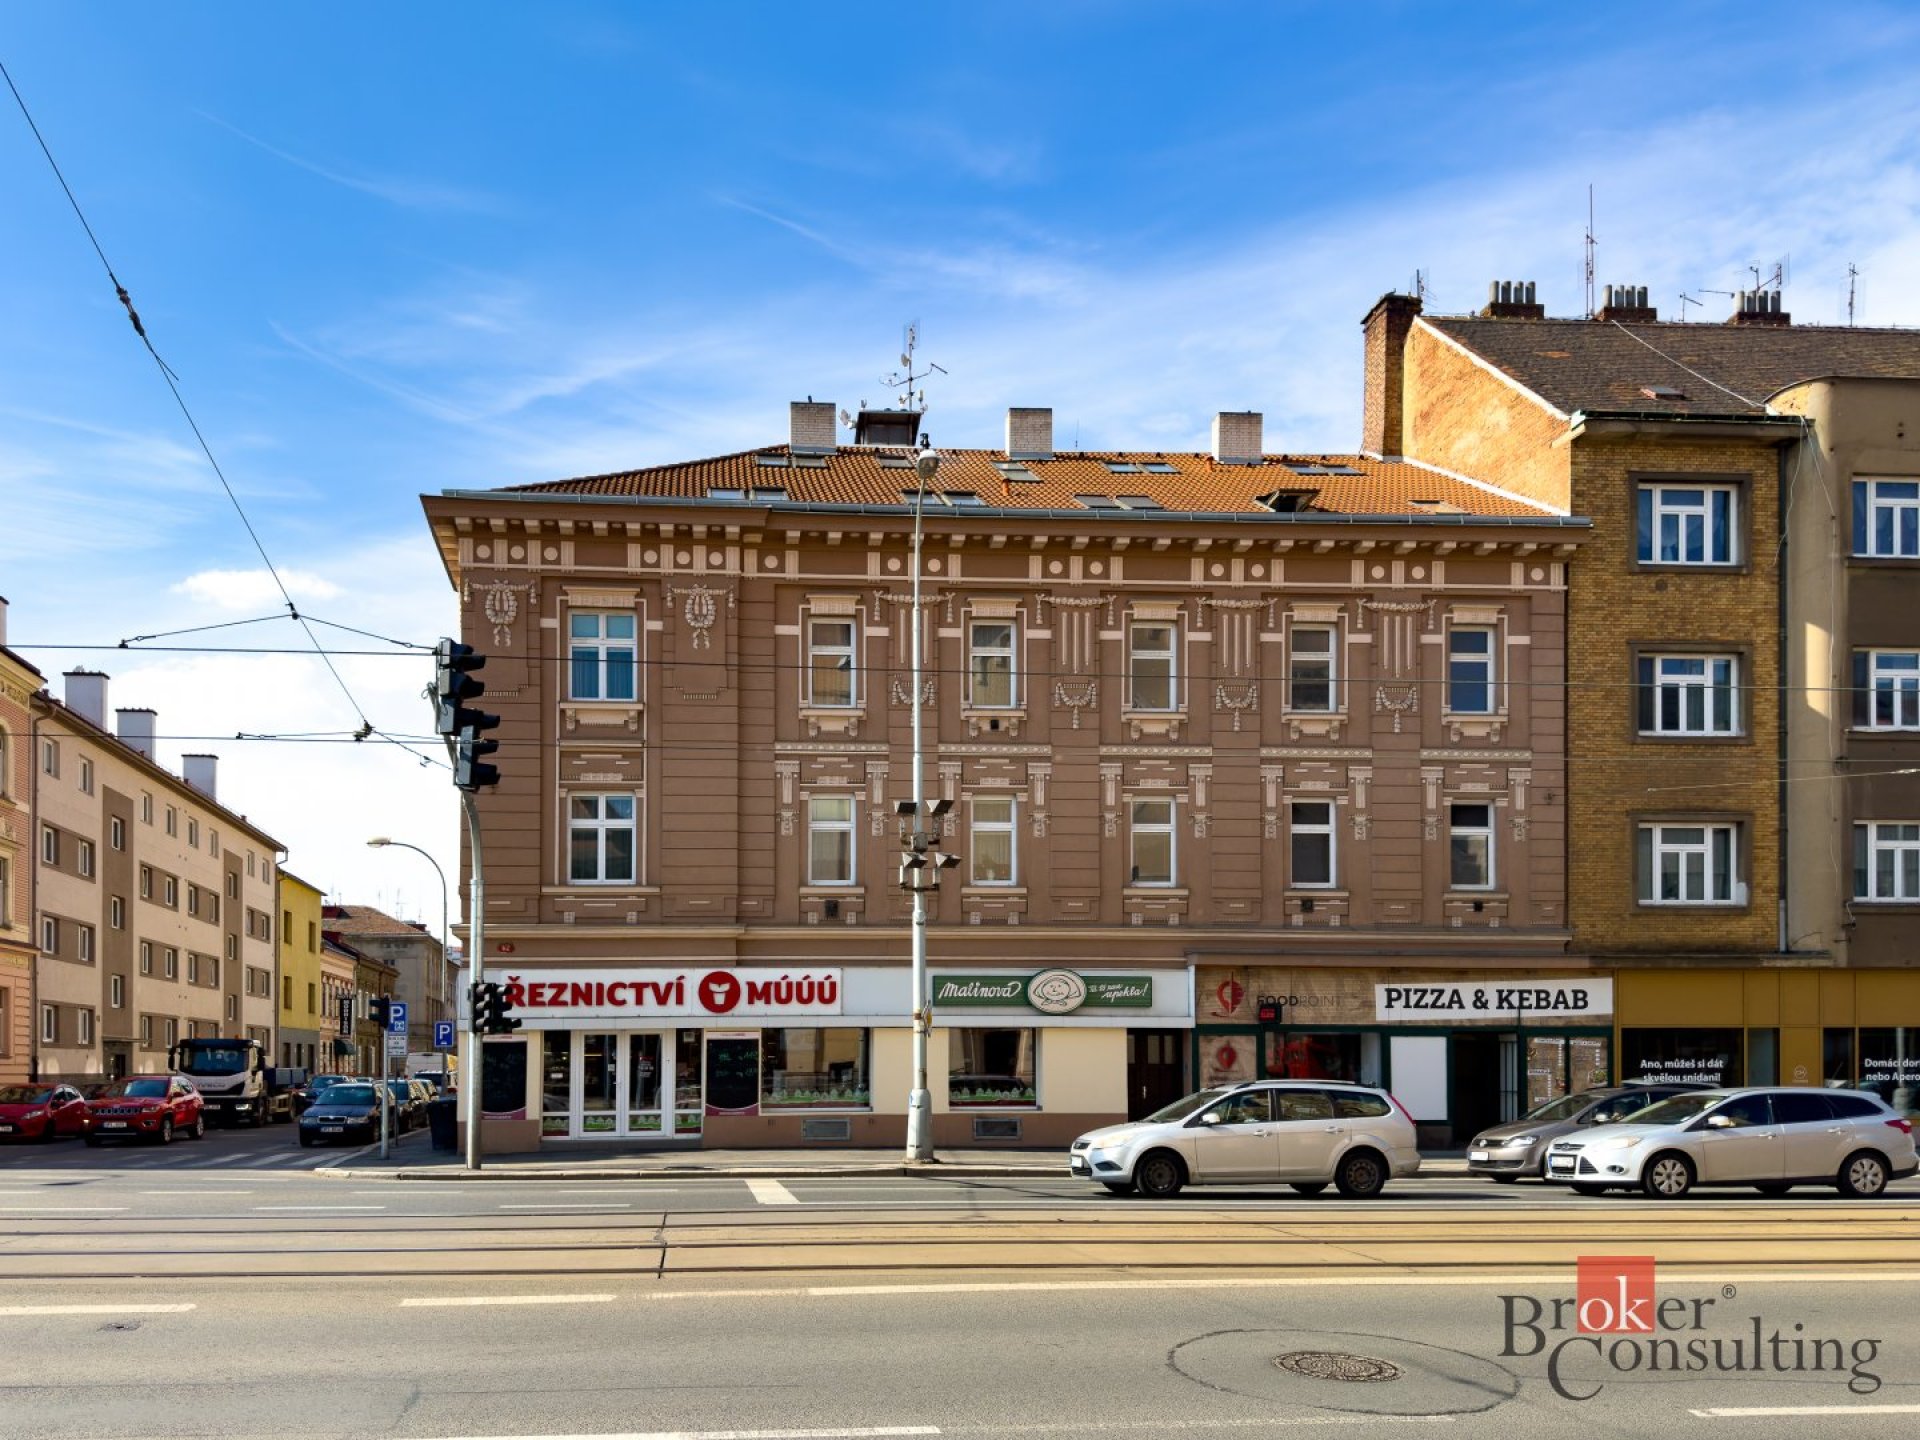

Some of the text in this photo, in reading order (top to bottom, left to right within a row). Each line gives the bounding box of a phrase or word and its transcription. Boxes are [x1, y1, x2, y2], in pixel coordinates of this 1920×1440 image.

[504, 974, 837, 1007] ŘEZNICTVÍ MÚÚÚ
[1384, 987, 1589, 1011] PIZZA & KEBAB
[390, 1006, 404, 1023] P
[439, 1025, 451, 1040] P
[1640, 1059, 1663, 1070] Ano,
[1697, 1059, 1705, 1069] si
[1707, 1058, 1724, 1069] dát
[1643, 1072, 1681, 1082] skvělou
[1866, 1071, 1890, 1081] nebo
